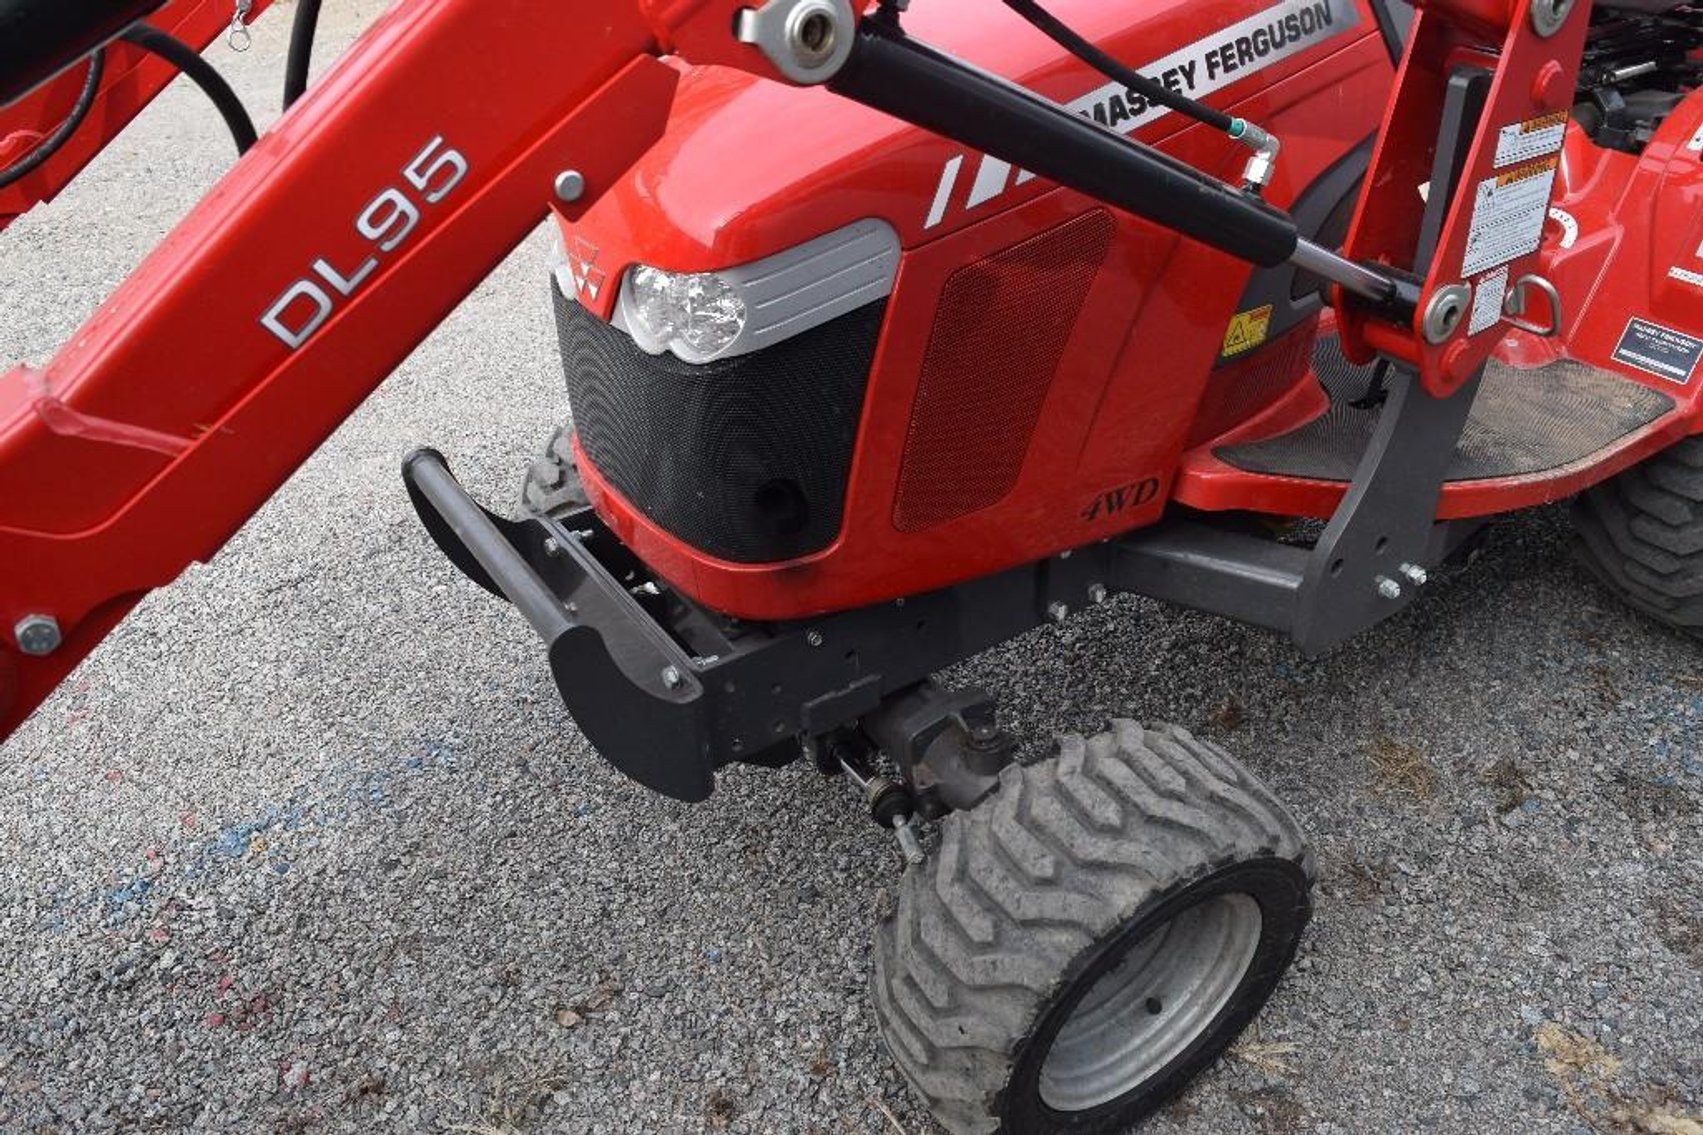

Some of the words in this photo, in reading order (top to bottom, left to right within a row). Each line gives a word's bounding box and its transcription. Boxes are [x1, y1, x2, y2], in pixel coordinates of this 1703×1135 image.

[1205, 0, 1333, 80] FERGUSON
[258, 134, 469, 349] DL95
[1081, 477, 1160, 521] 4WD
